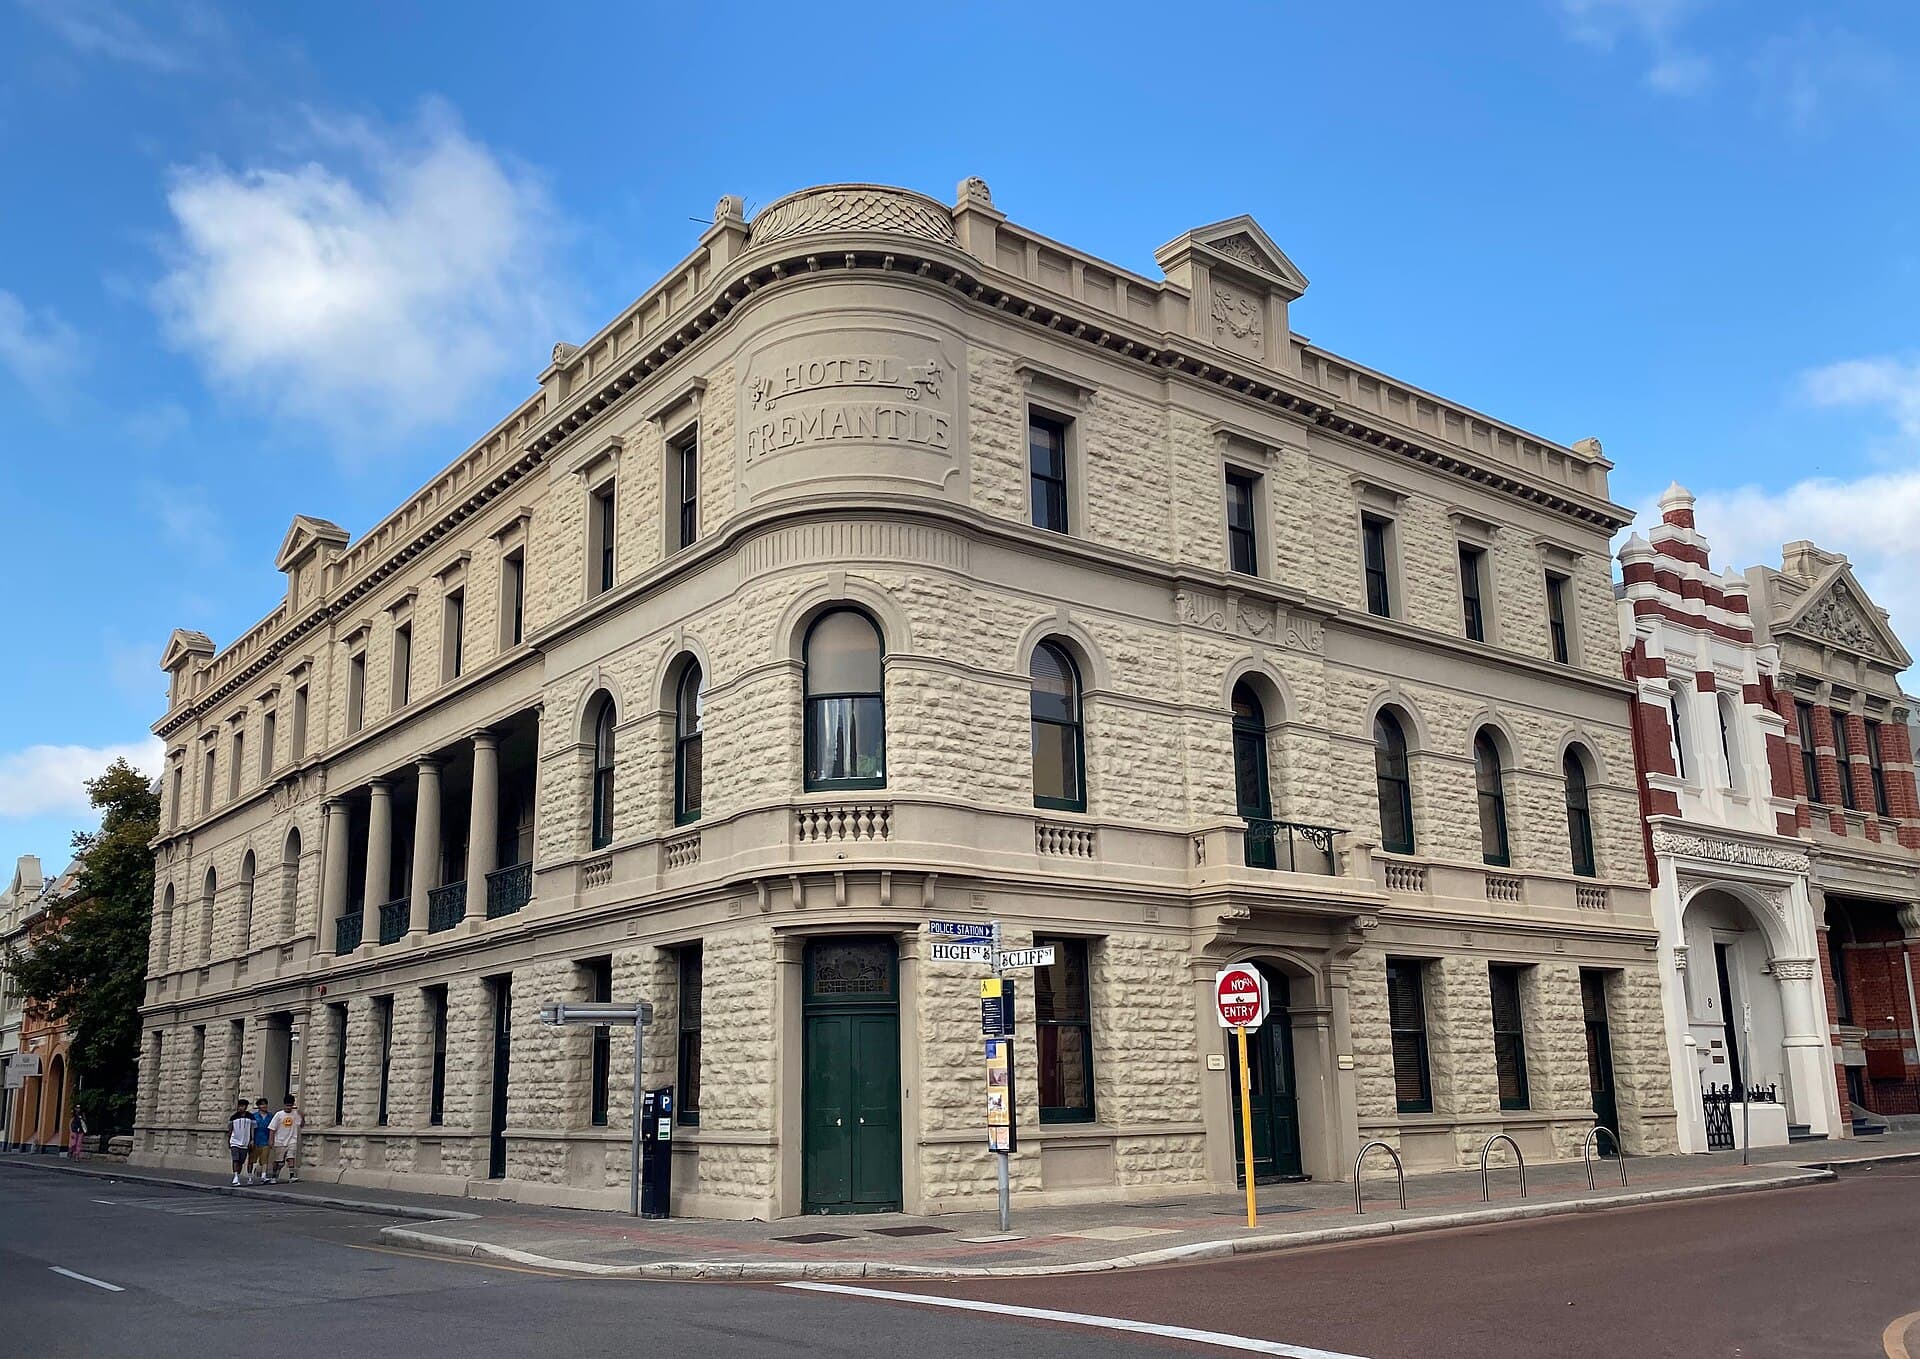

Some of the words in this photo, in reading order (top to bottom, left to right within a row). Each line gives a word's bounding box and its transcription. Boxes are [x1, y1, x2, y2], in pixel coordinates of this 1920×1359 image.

[782, 359, 899, 392] HOTEL
[746, 407, 951, 463] FREMANTLE
[930, 922, 954, 934] POLICE
[957, 925, 984, 936] STATION
[932, 944, 972, 960] HIGH
[972, 946, 981, 954] ST
[1008, 950, 1045, 966] CLIFF
[1044, 948, 1053, 957] ST
[1231, 979, 1244, 991] NO
[1708, 997, 1713, 1008] 8
[1224, 1006, 1254, 1018] ENTRY
[663, 1096, 670, 1109] P
